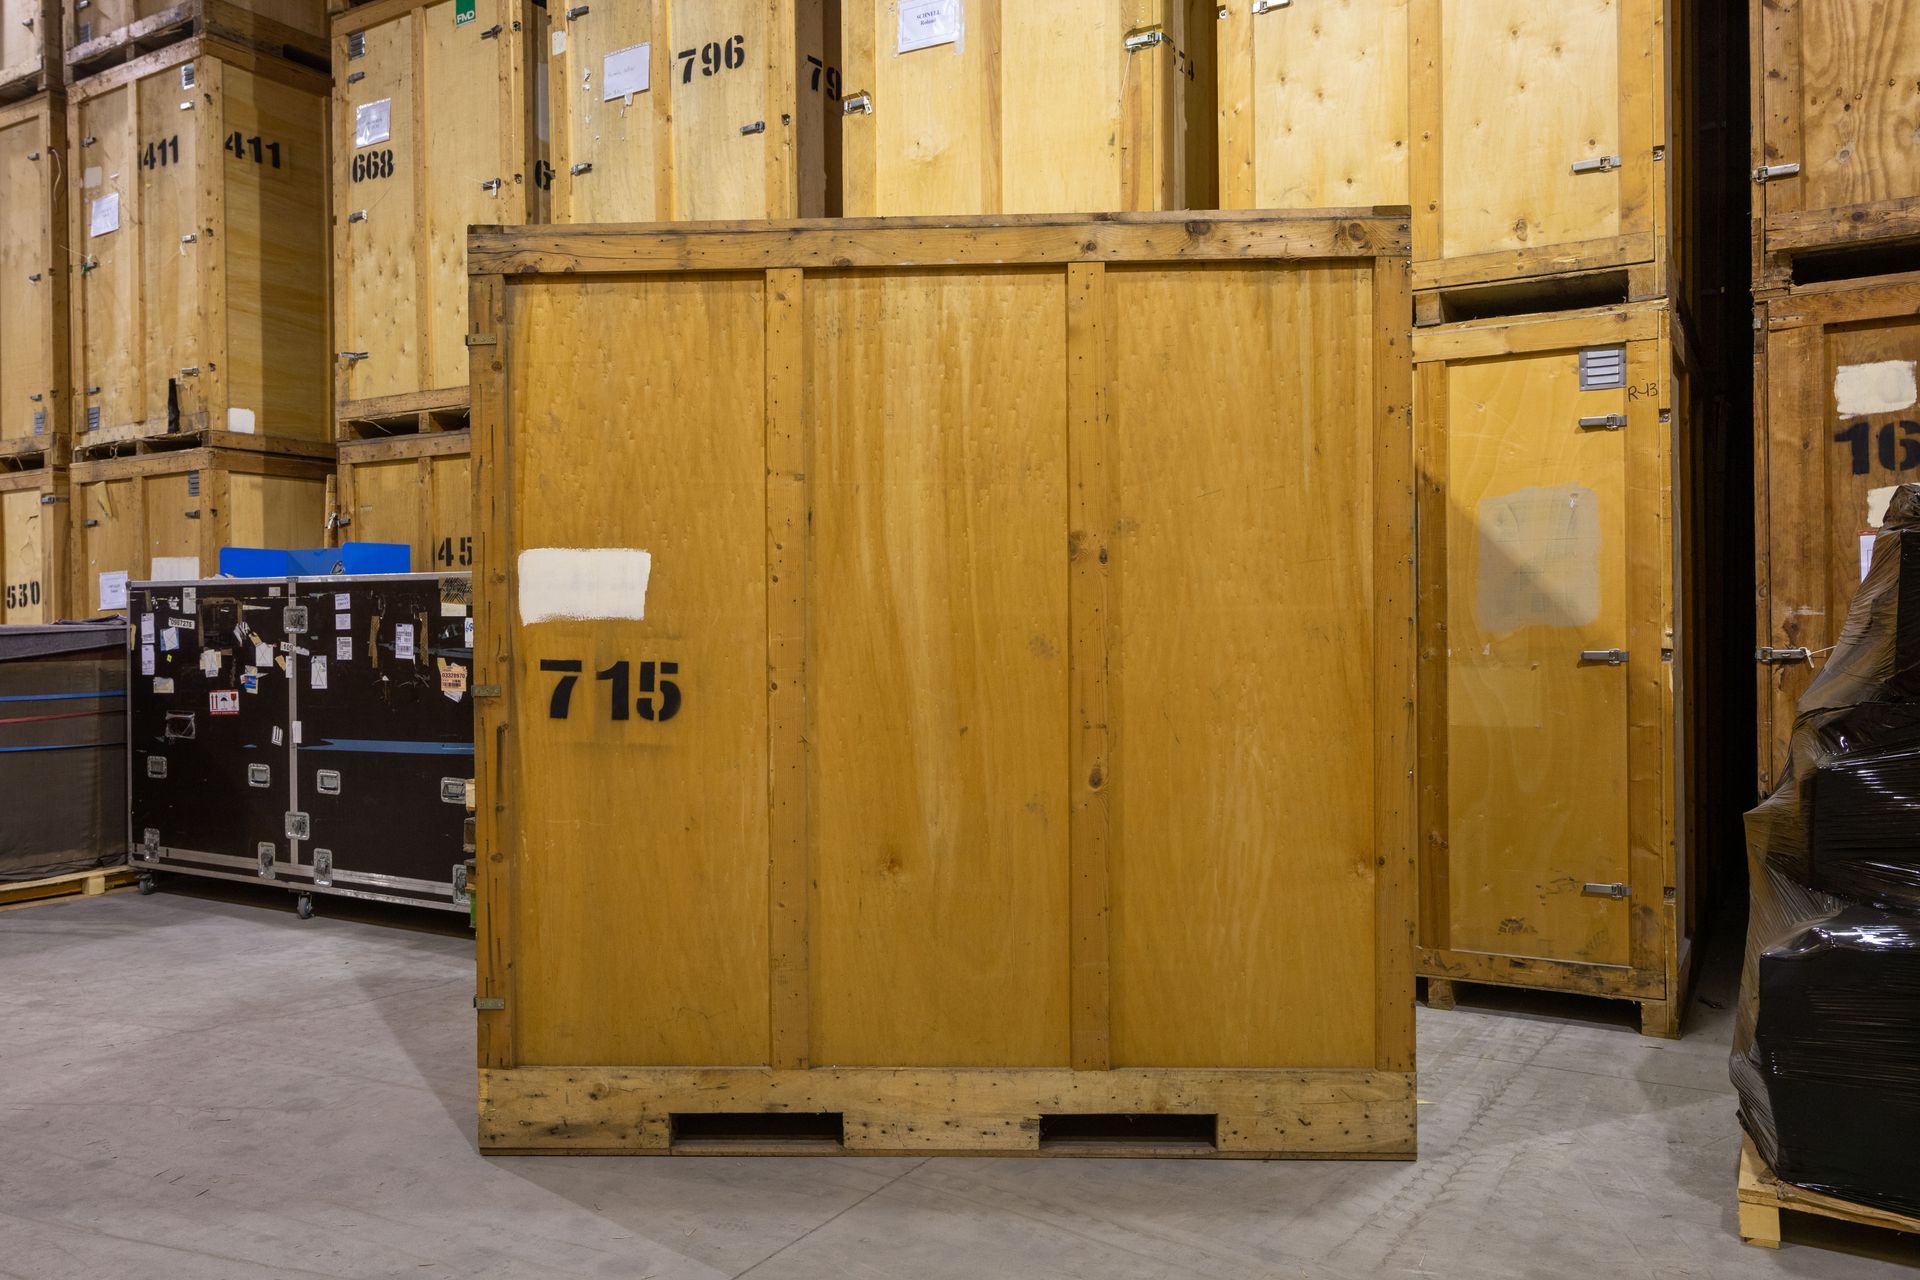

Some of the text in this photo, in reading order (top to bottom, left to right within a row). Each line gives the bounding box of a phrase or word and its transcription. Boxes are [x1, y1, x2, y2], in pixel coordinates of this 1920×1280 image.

[457, 10, 475, 24] FMD
[678, 34, 745, 84] 796
[143, 134, 179, 170] 411
[225, 131, 281, 169] 411
[352, 149, 394, 183] 668
[1834, 421, 1920, 475] 16
[438, 537, 473, 566] 45
[6, 581, 41, 609] 530
[540, 659, 682, 722] 715
